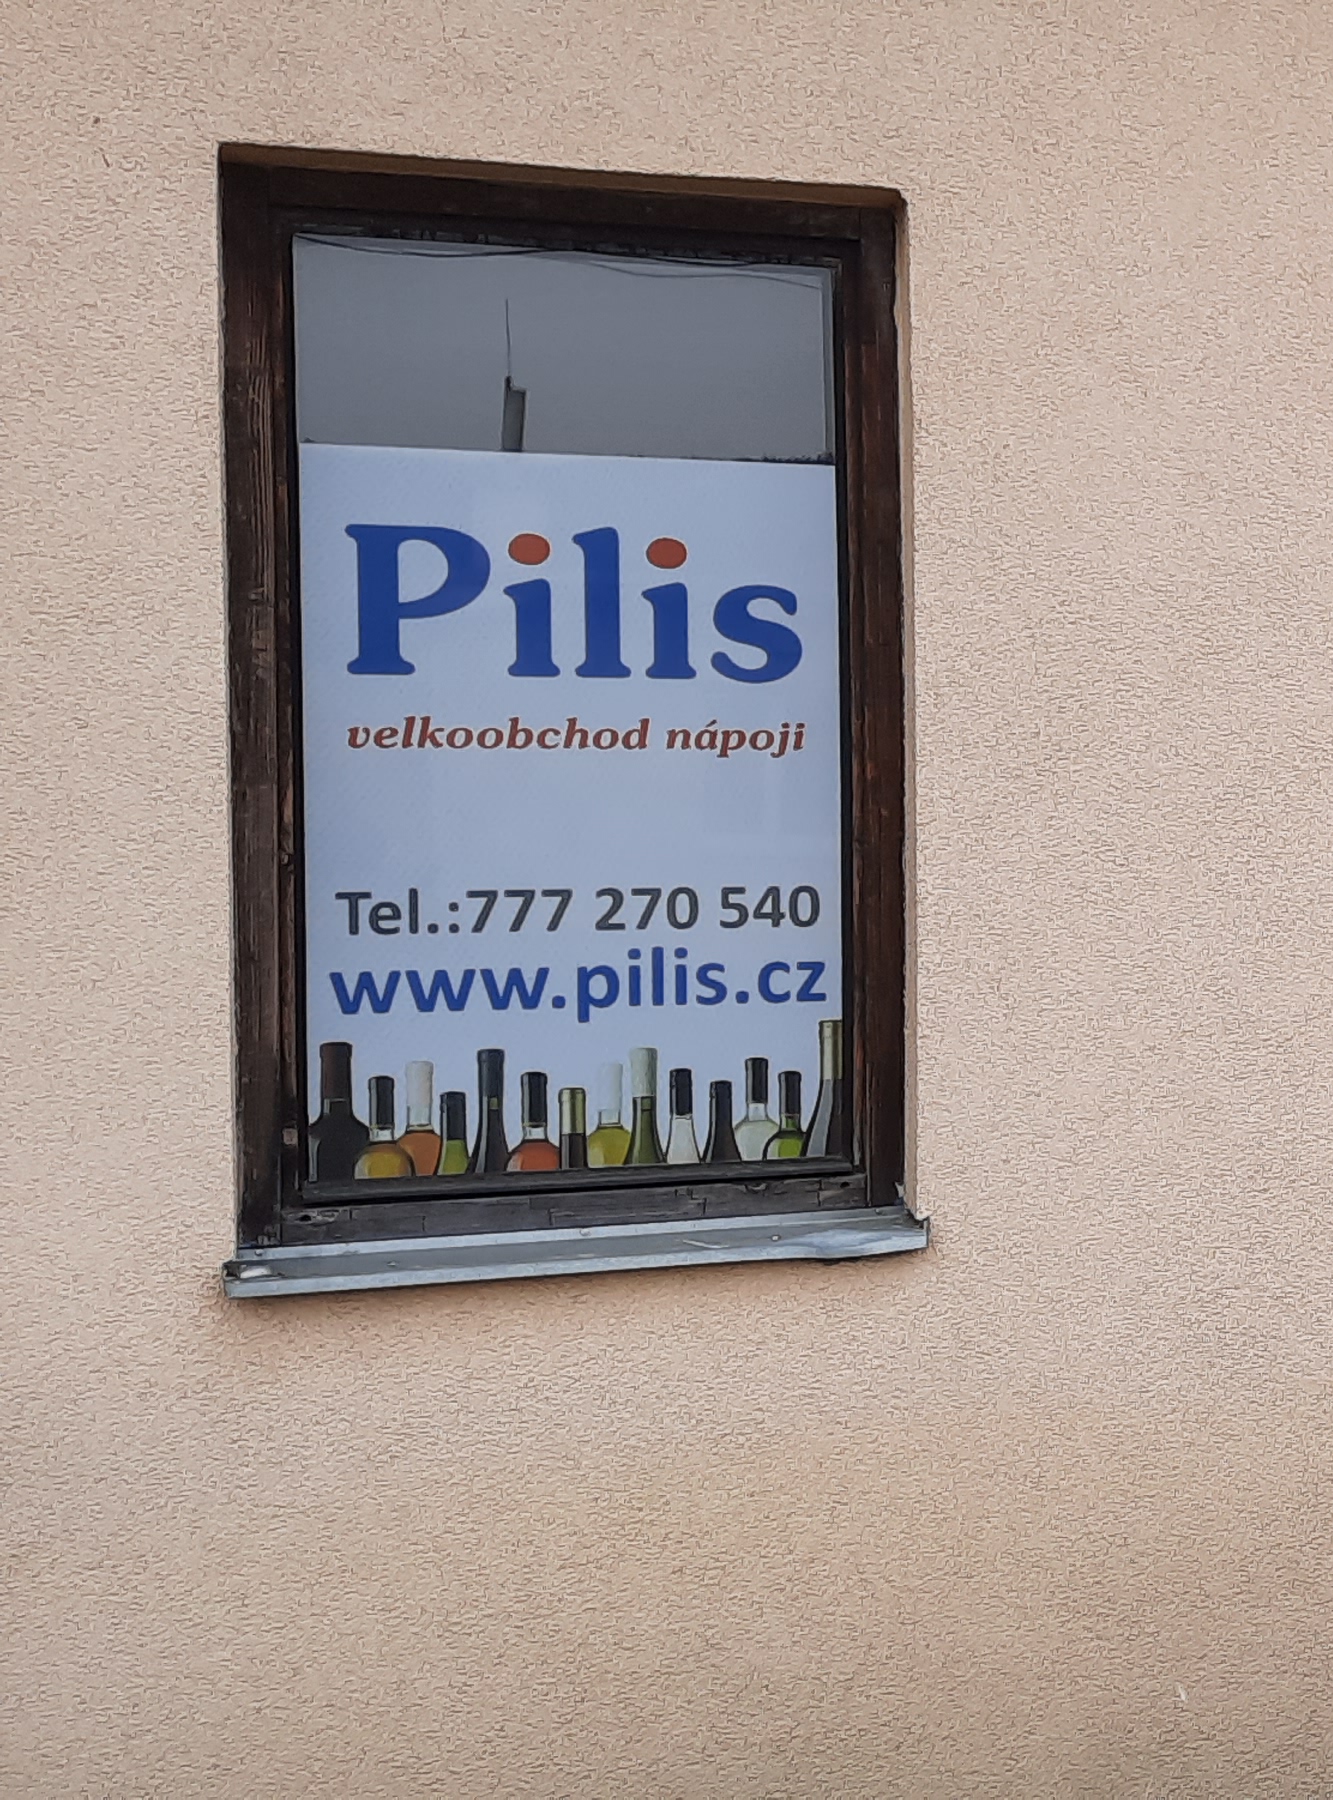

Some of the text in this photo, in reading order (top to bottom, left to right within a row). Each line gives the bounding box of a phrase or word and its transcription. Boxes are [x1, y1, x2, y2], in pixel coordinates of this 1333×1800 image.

[344, 523, 802, 684] Pilis
[346, 716, 805, 759] velkoobchod nápoji
[335, 885, 821, 936] Tel.:777 270 540
[329, 947, 828, 1023] www.pilis.cz
